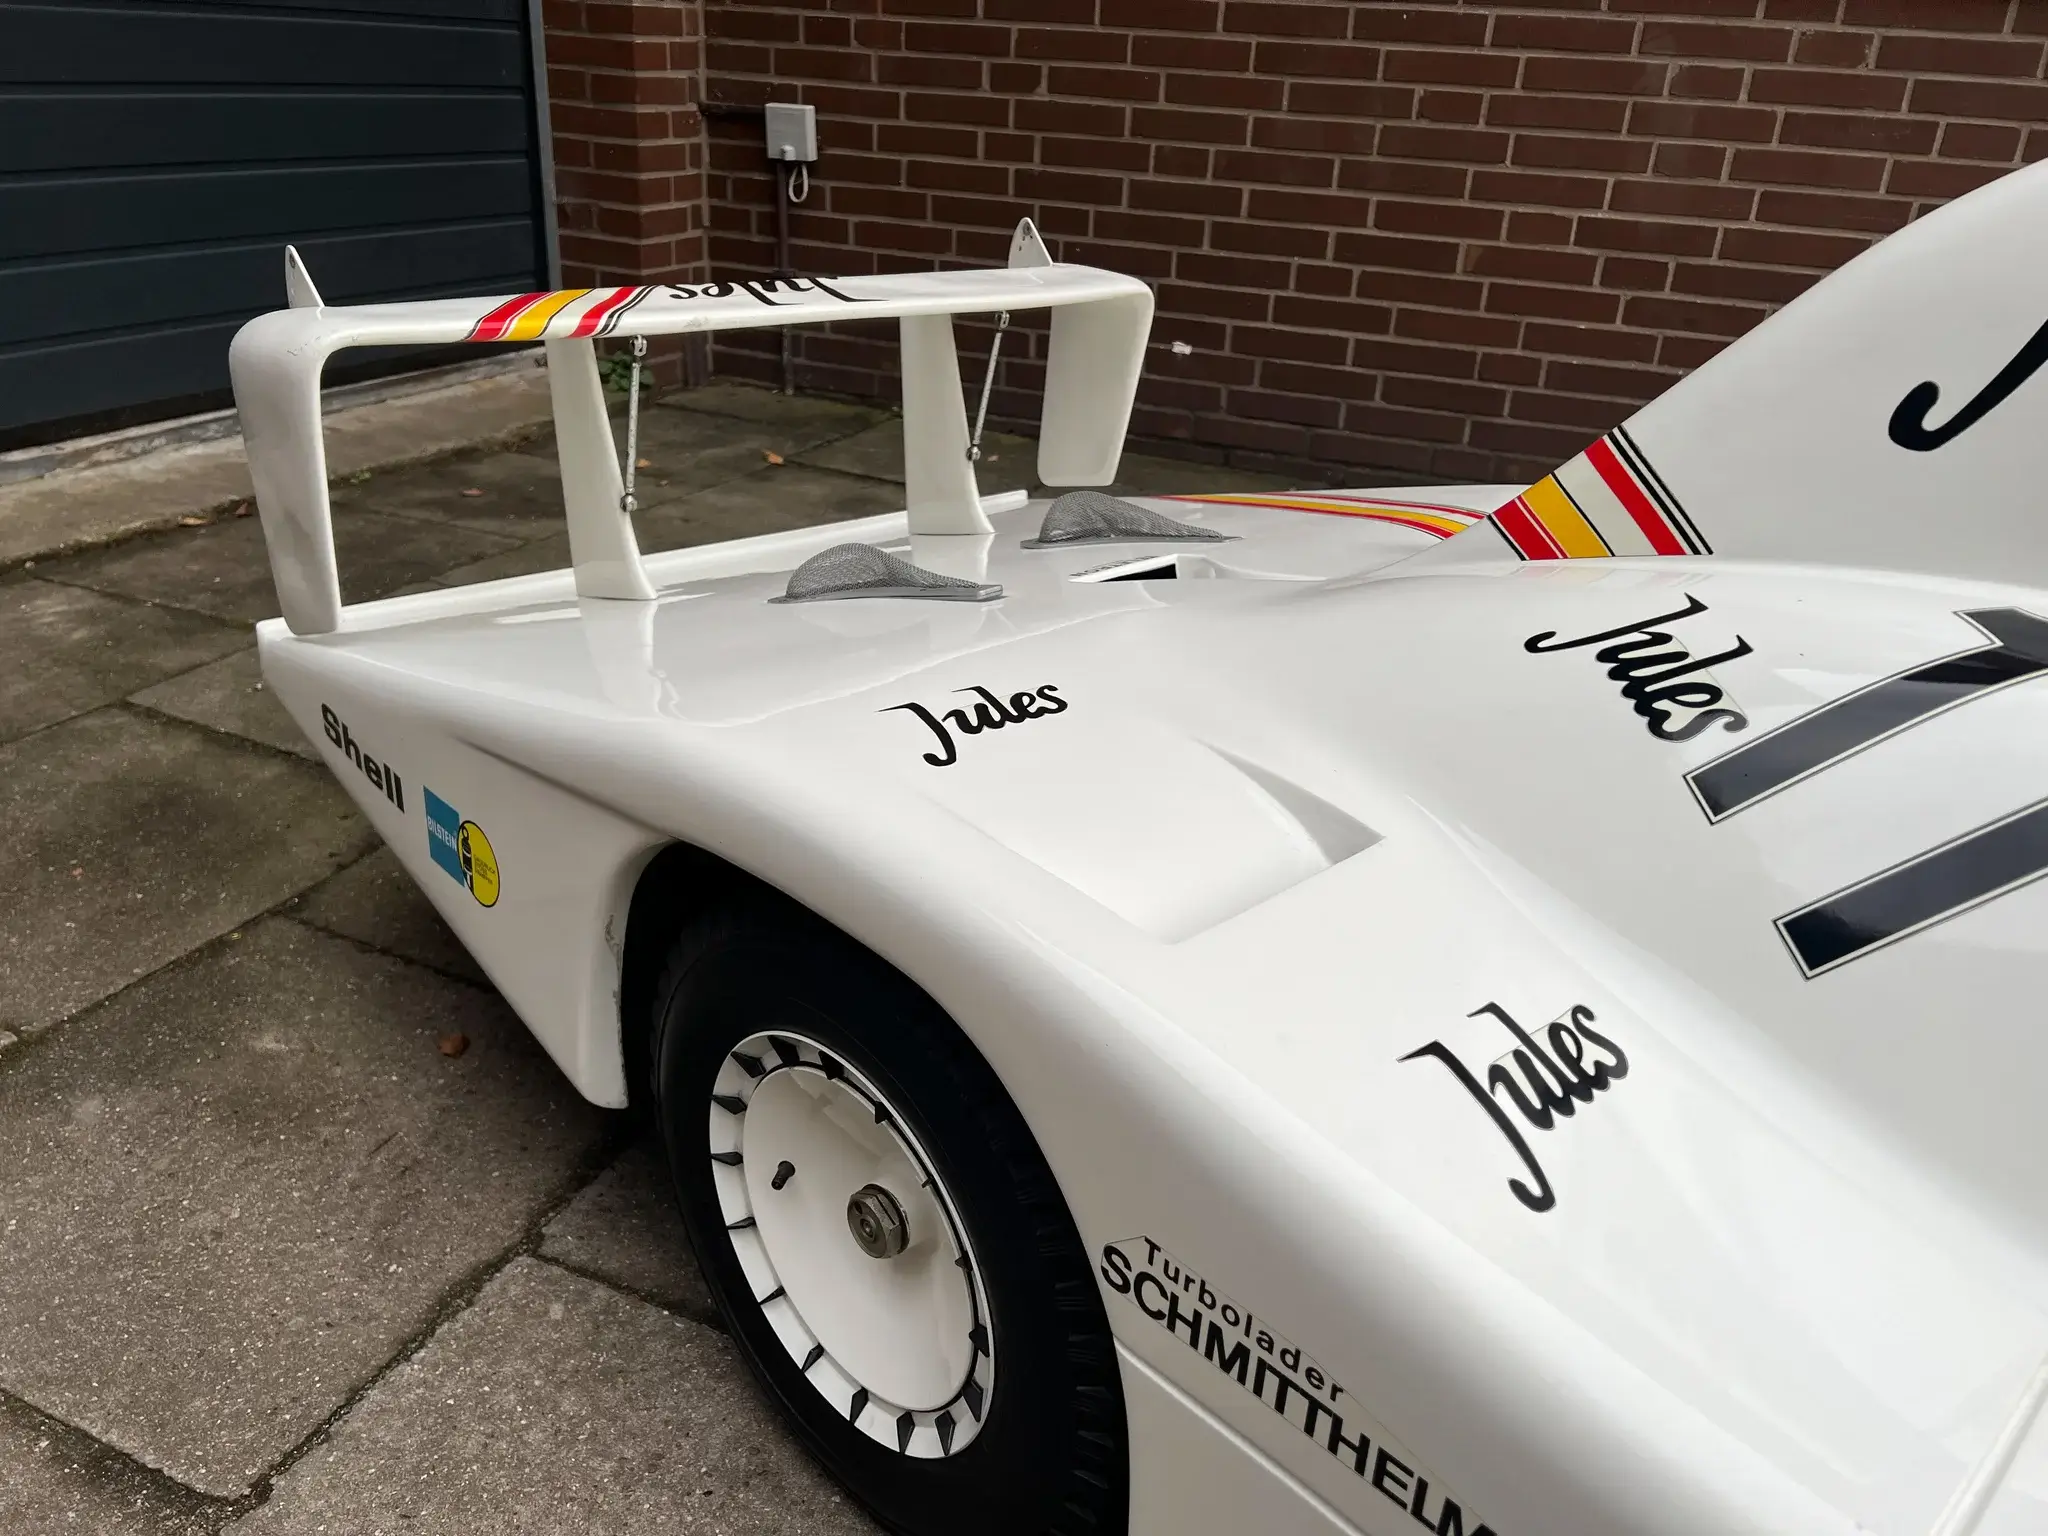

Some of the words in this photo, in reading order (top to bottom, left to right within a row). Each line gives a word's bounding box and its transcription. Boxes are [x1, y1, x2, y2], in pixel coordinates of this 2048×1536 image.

[875, 685, 1068, 767] Jules
[1524, 592, 1754, 743] Jules
[321, 703, 405, 814] Shell
[427, 815, 457, 851] BILSTEIN
[1396, 1001, 1629, 1212] Jules
[1144, 1236, 1344, 1401] Turbolader
